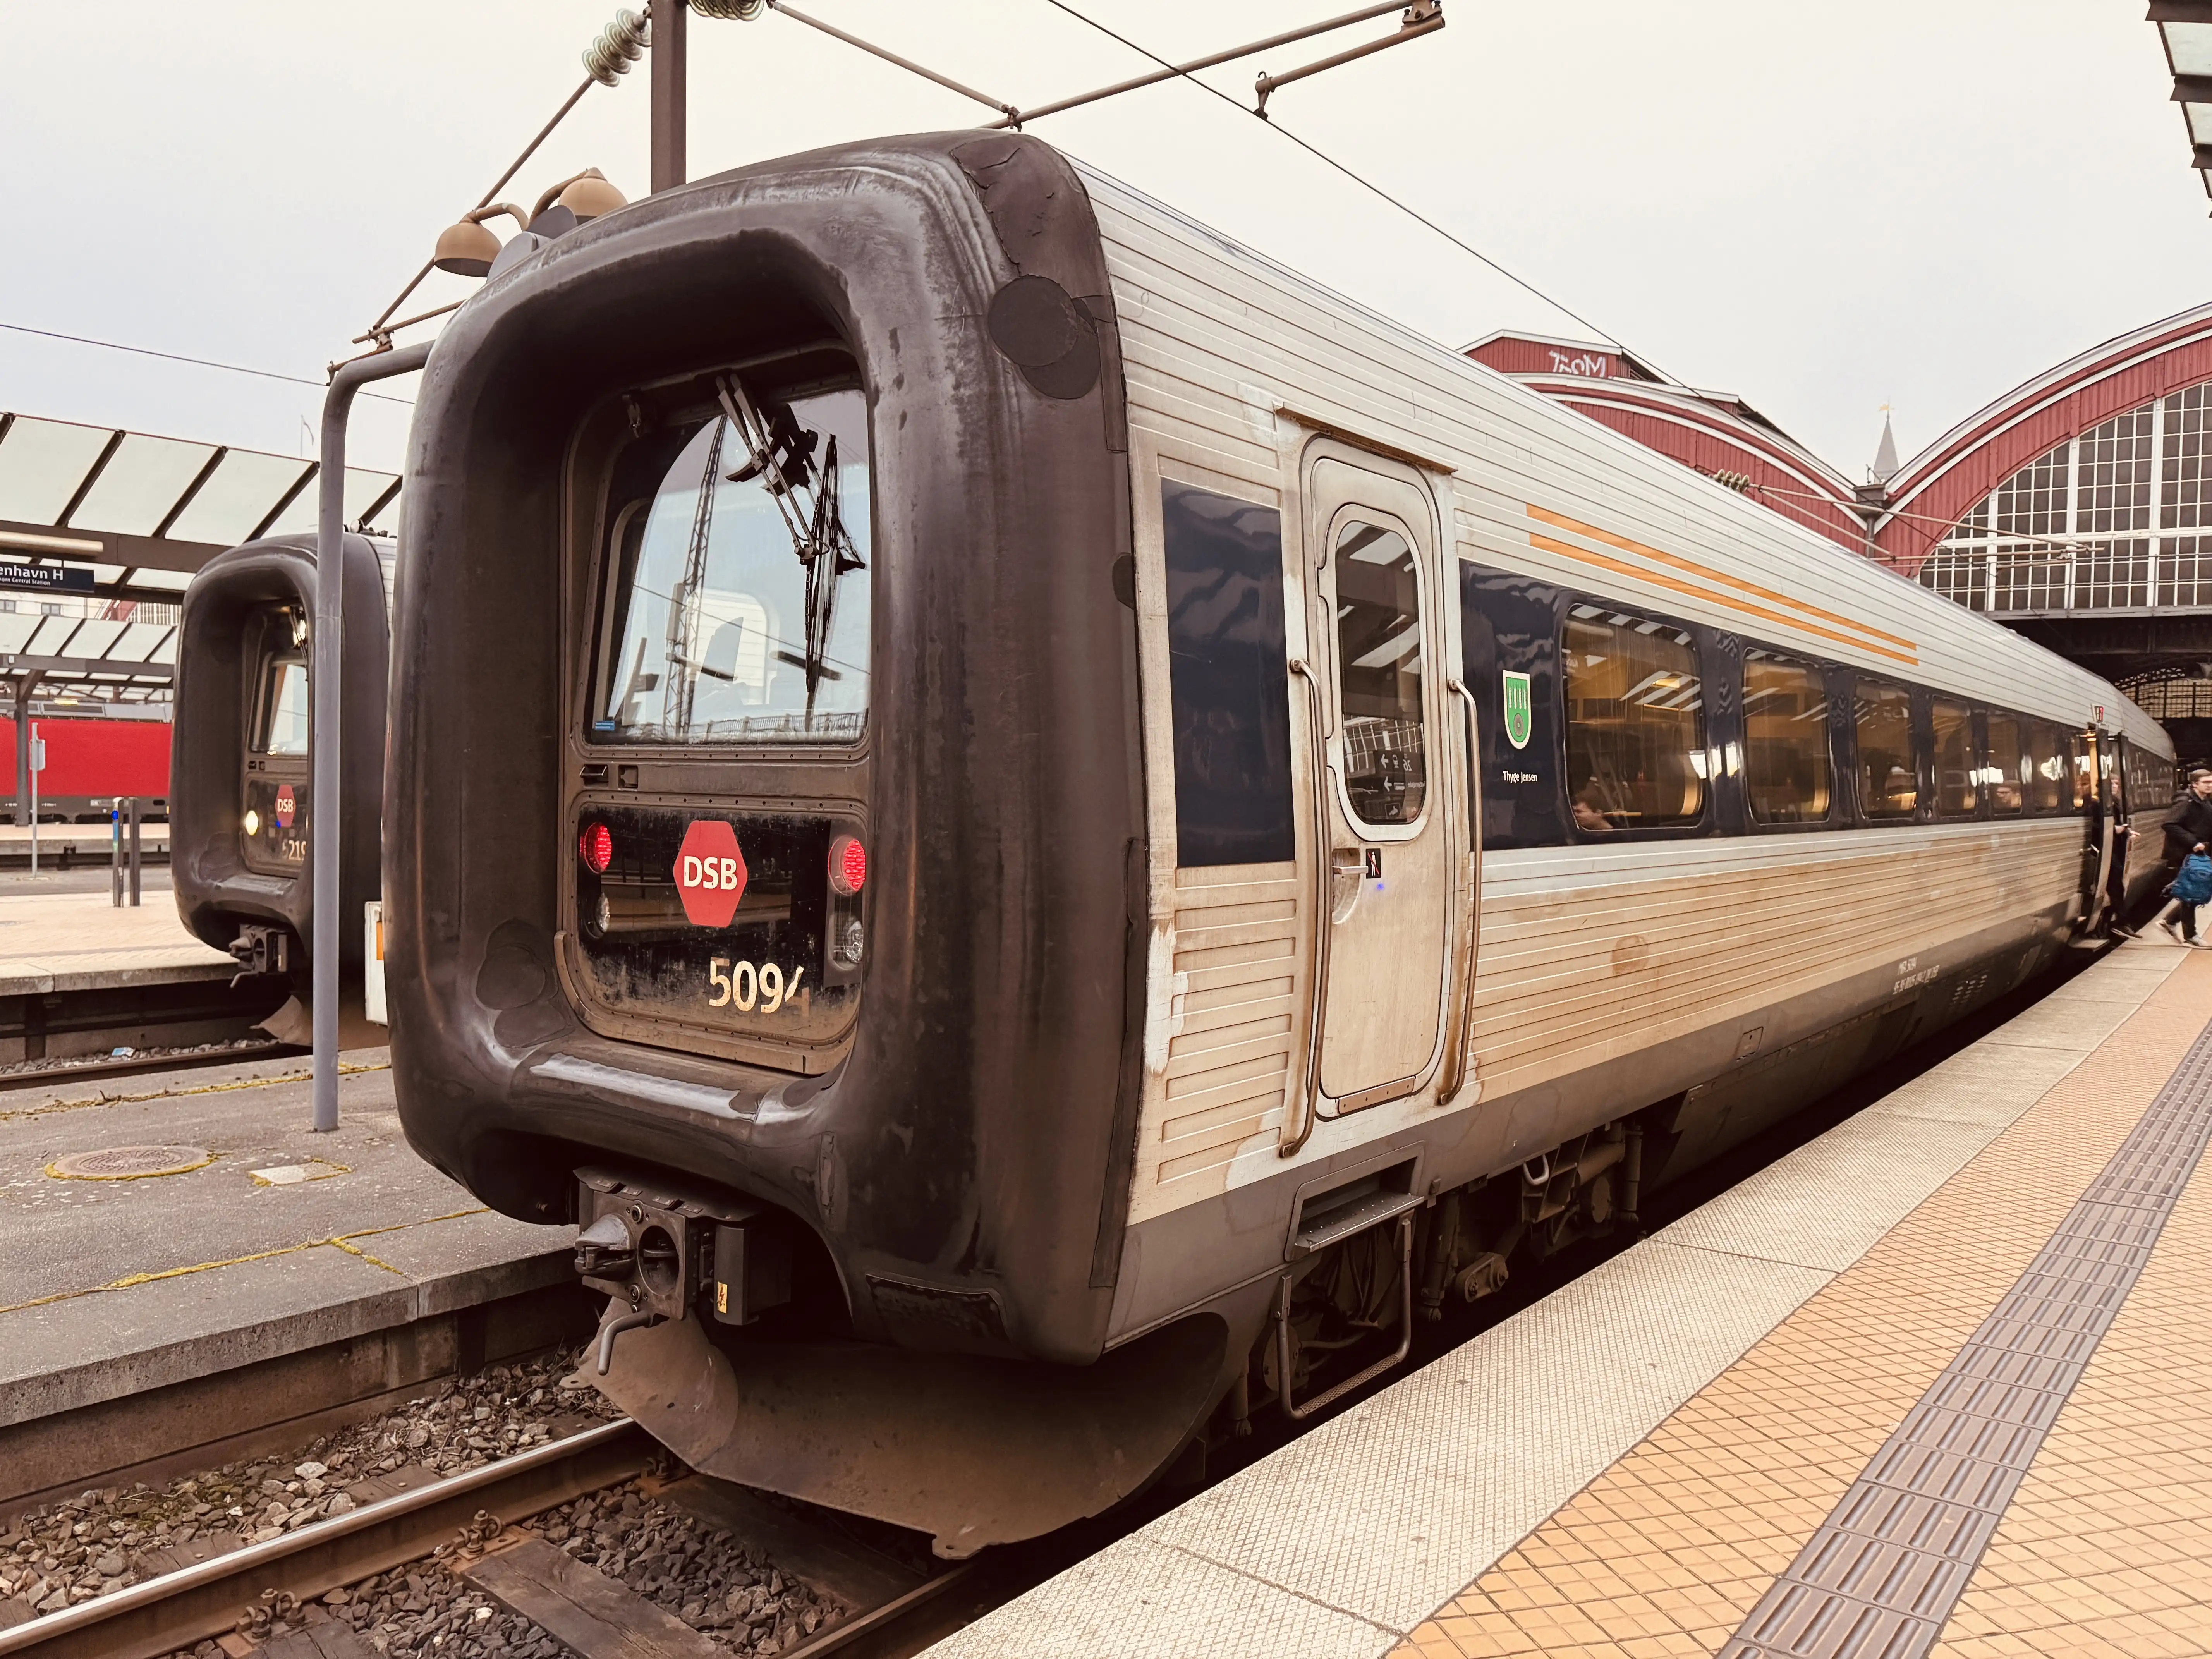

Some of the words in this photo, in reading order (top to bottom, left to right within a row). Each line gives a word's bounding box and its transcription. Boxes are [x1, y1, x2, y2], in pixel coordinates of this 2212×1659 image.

[53, 569, 63, 580] H
[1503, 771, 1520, 784] Thyge
[1521, 771, 1537, 783] Jensen
[277, 798, 294, 812] DSB
[684, 856, 737, 890] DSB
